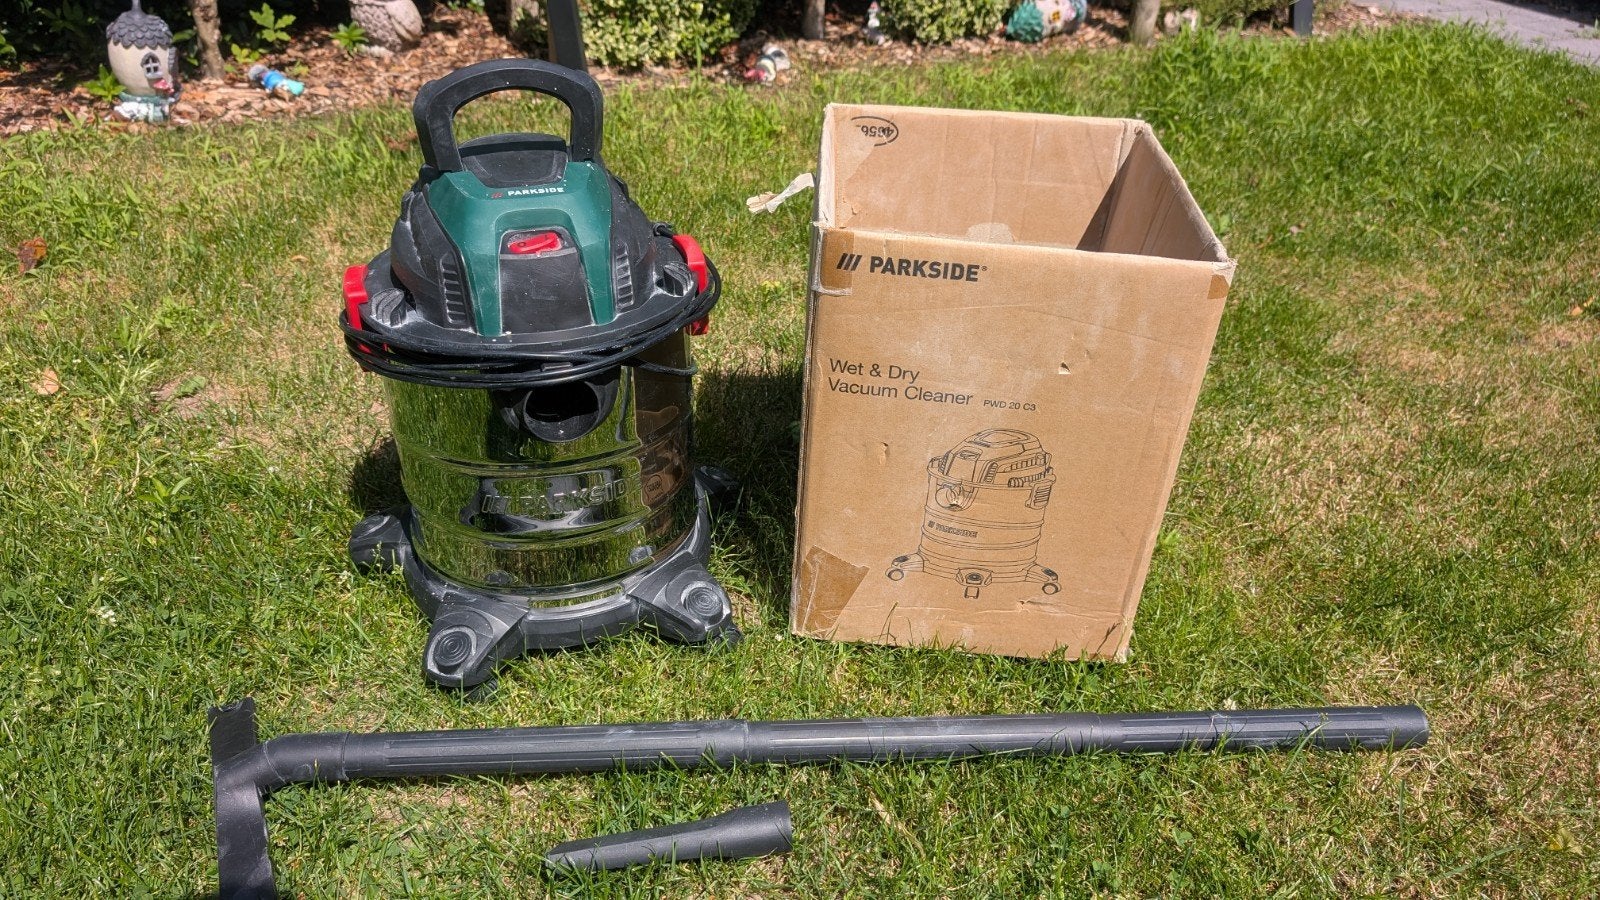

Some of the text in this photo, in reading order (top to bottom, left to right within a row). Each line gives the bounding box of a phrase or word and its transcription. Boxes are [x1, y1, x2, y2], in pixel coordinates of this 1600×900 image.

[507, 187, 565, 196] PARKSIDE
[829, 358, 920, 384] Wet & Dry
[828, 377, 973, 406] Vacuum Cleaner
[983, 399, 1036, 412] PWD 20 C3
